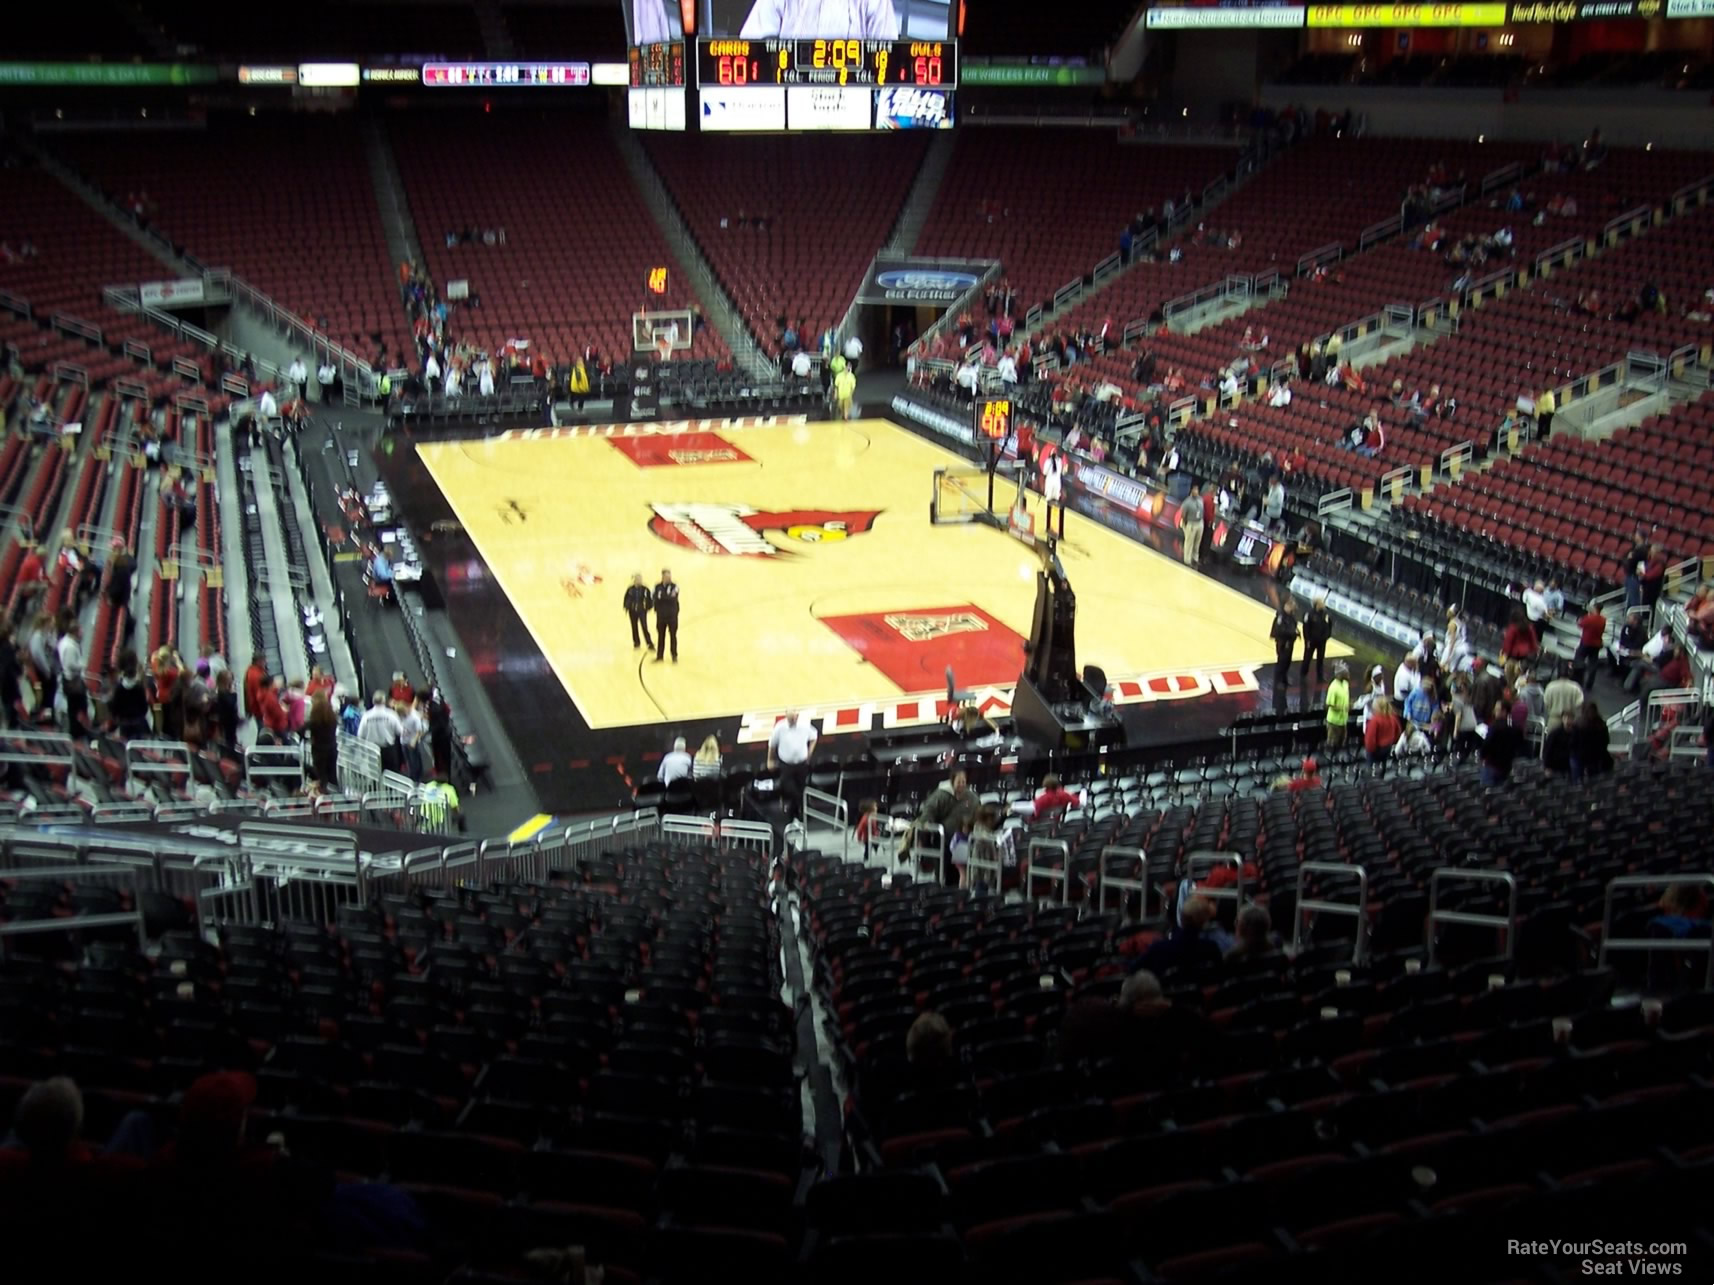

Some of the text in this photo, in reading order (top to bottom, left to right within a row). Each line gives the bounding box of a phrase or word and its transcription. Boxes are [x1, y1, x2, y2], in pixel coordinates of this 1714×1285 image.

[1512, 1, 1577, 24] Hard Rock Cafe
[710, 41, 750, 56] CARDS
[814, 40, 860, 68] 2:09
[911, 42, 942, 57] OWLS
[719, 56, 747, 85] 60
[808, 70, 836, 83] PERIOD
[915, 57, 941, 85] 50
[985, 401, 1009, 417] 2:09
